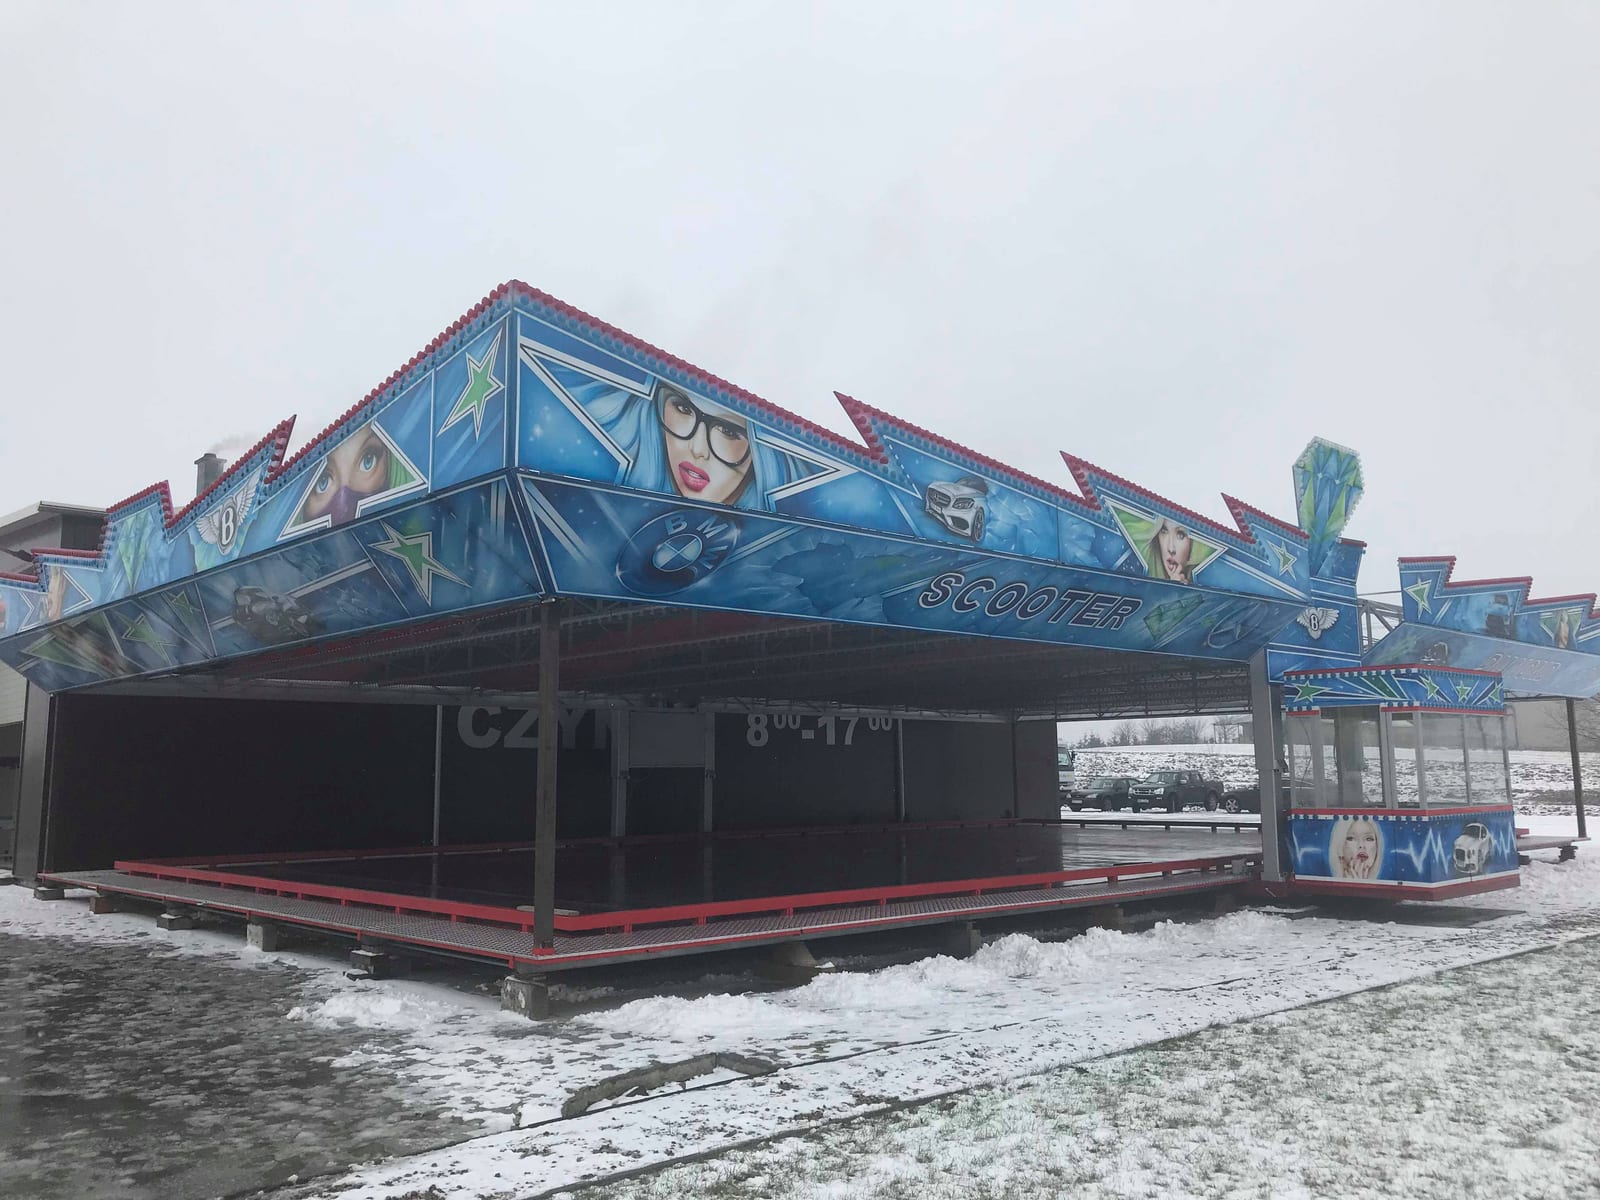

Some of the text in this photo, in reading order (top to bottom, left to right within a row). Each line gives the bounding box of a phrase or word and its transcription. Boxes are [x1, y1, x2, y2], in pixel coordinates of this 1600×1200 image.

[221, 507, 235, 545] B
[665, 514, 728, 570] BMW
[919, 572, 1143, 630] SCOOTER
